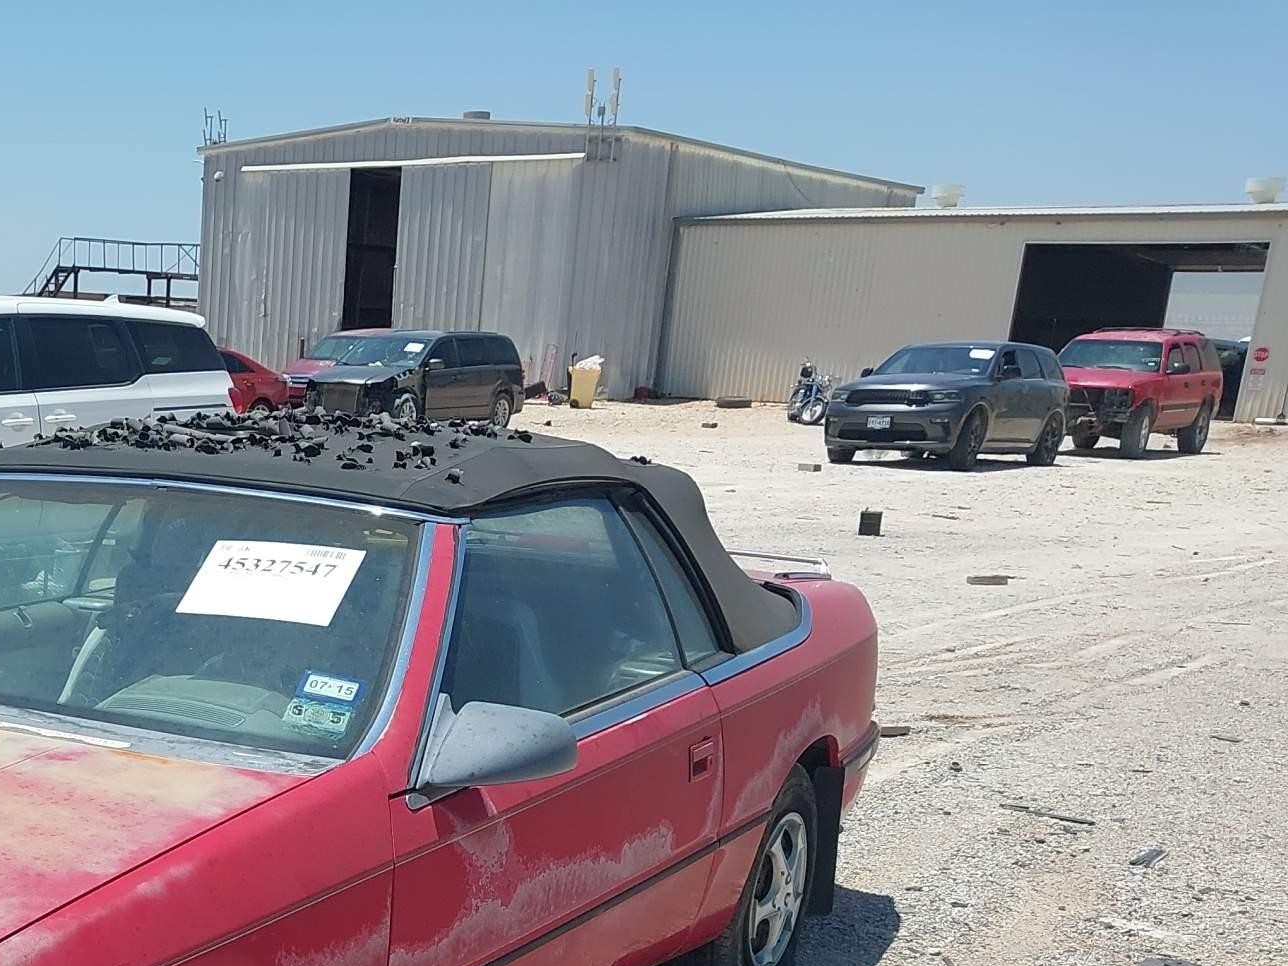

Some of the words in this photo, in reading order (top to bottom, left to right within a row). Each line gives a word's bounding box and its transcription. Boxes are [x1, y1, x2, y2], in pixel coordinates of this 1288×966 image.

[218, 557, 339, 578] 45327547
[309, 680, 328, 690] 07
[336, 684, 355, 696] 15
